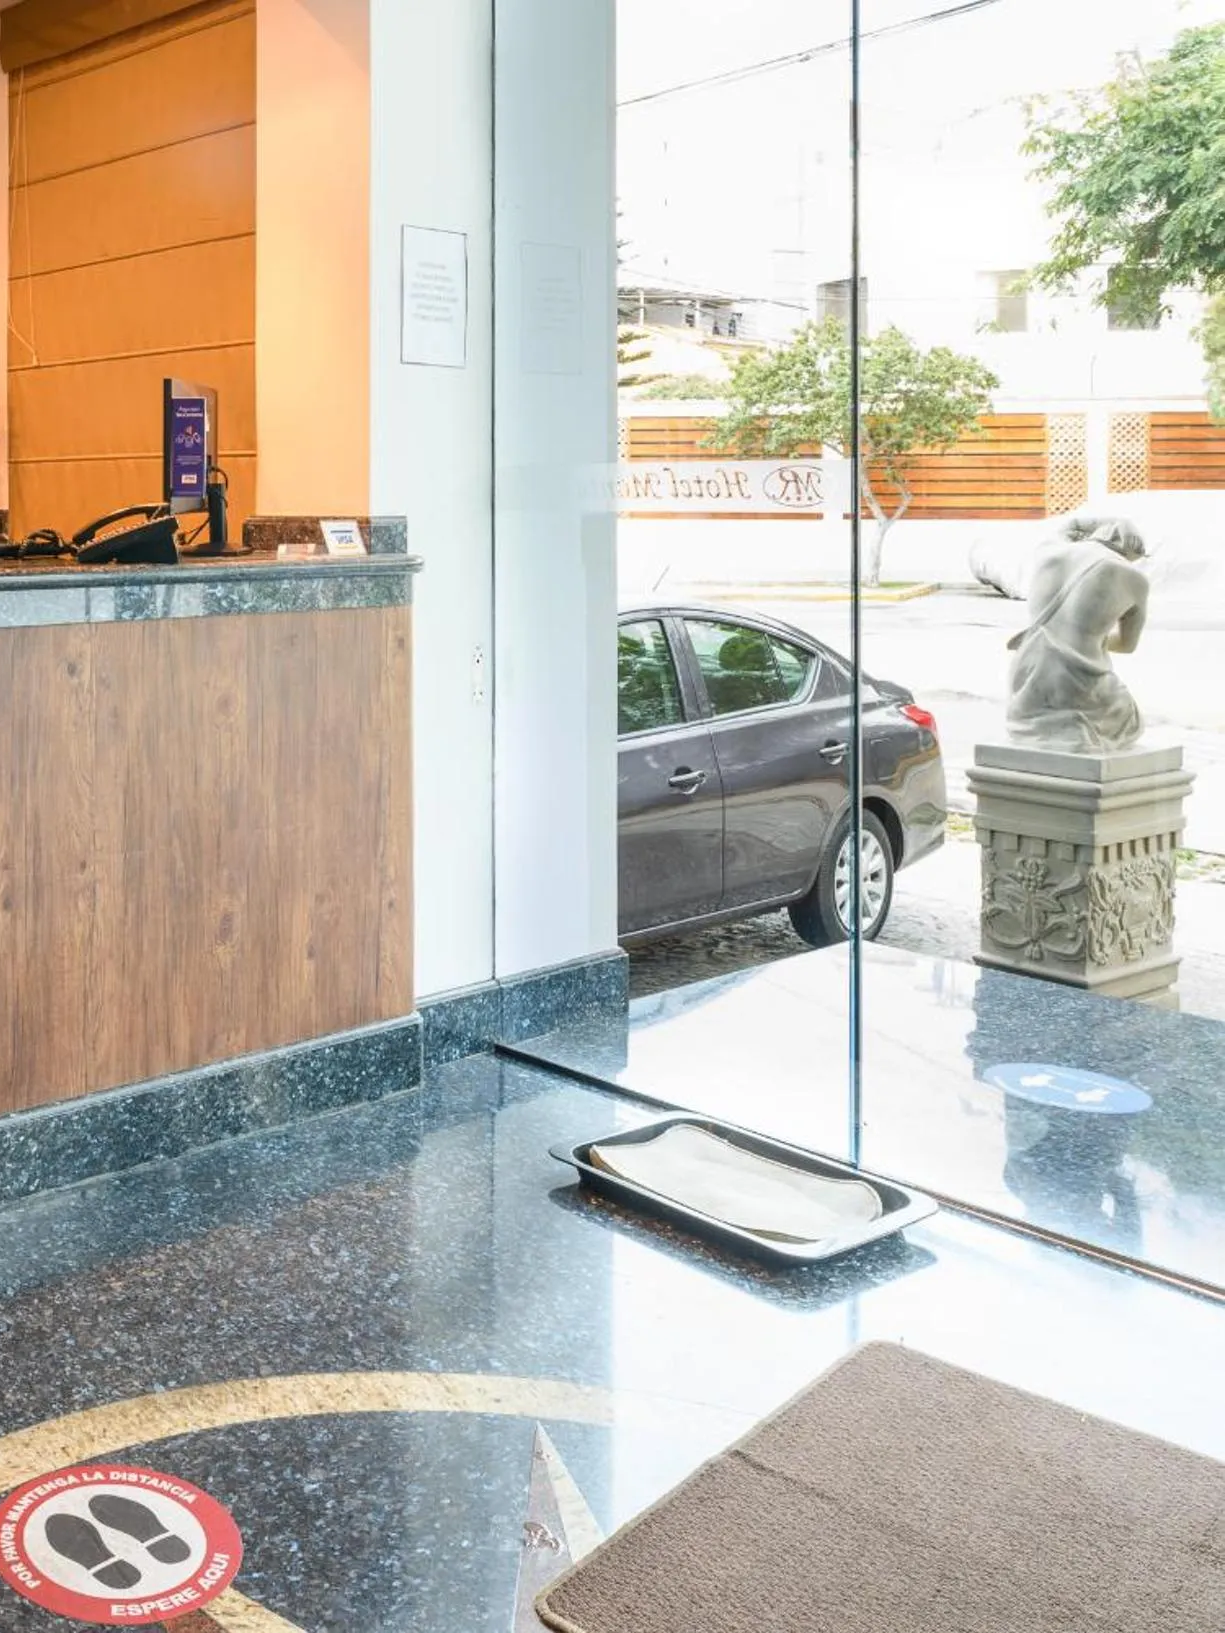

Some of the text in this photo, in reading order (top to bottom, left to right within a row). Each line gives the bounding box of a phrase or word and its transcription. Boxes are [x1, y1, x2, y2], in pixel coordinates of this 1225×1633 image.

[1, 1470, 198, 1590] POR FAVOR MANTENGA LA DISTANCIA
[110, 1587, 202, 1617] ESPERE
